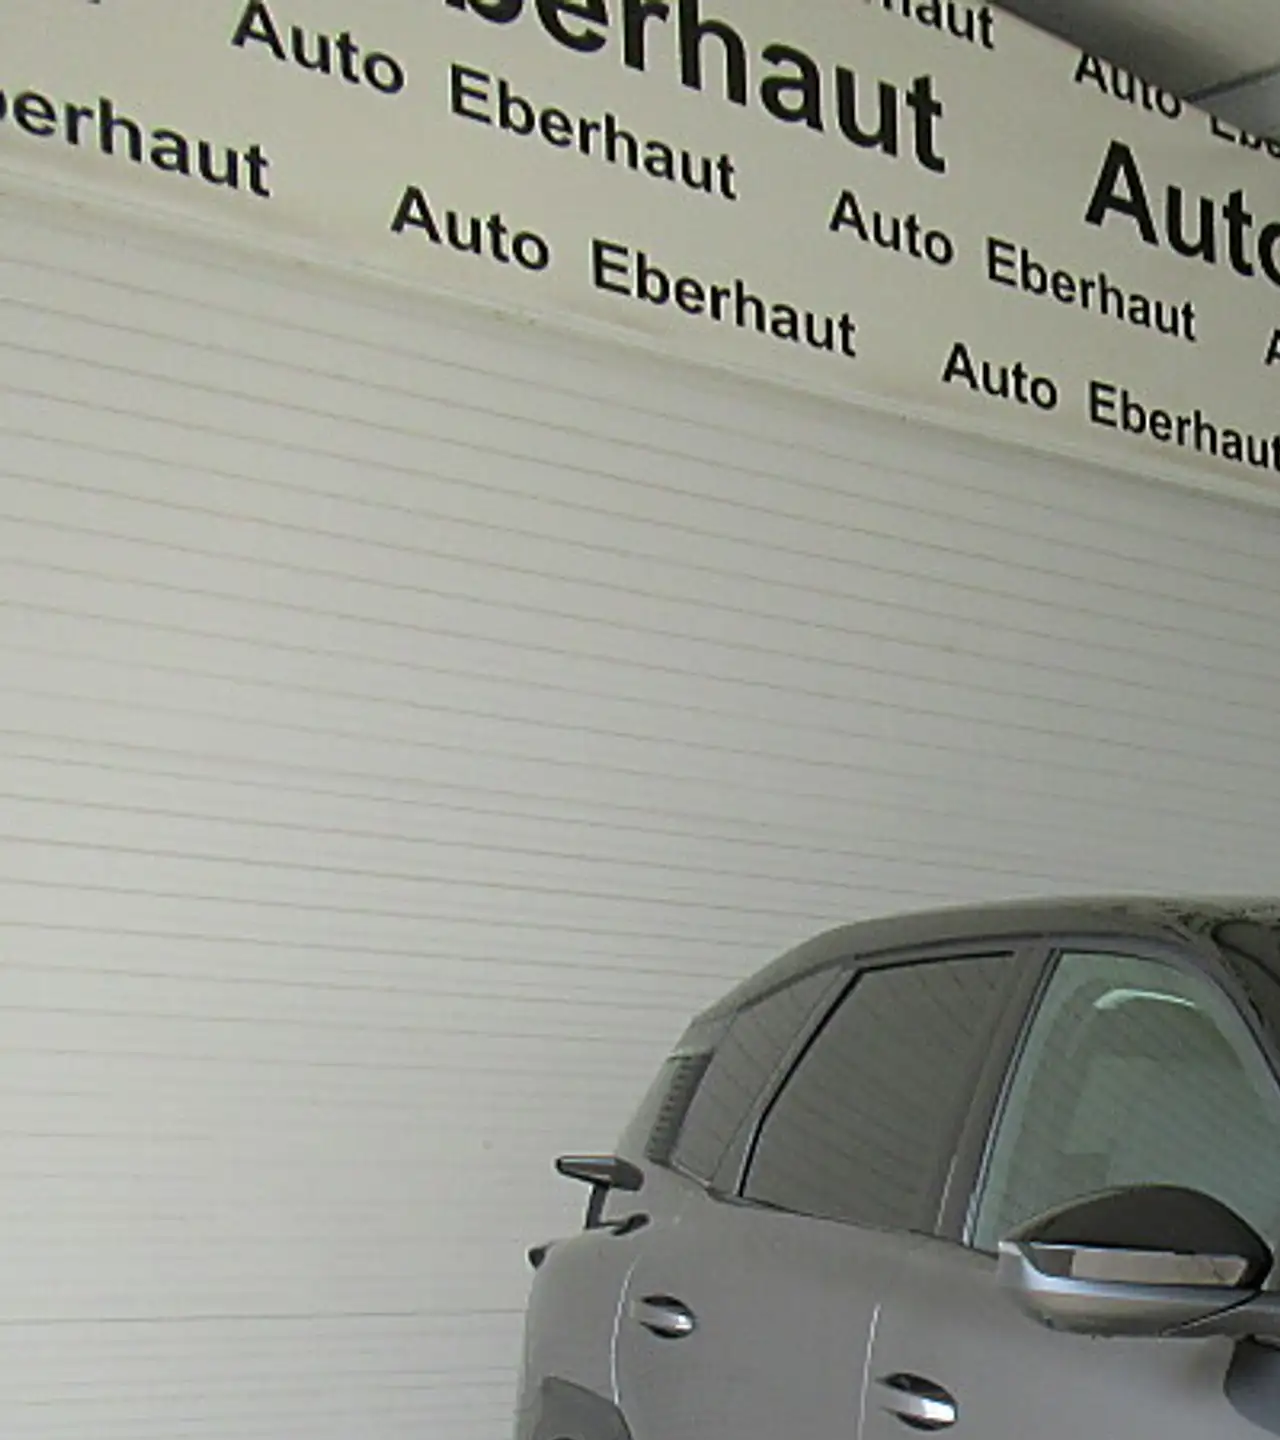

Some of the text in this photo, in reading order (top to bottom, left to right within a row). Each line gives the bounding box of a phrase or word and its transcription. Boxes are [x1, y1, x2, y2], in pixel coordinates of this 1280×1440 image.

[0, 89, 271, 198] erhaut
[231, 0, 737, 201] Auto Eberhaut
[444, 0, 946, 174] erhaut
[390, 184, 857, 359] Auto Eberhaut
[828, 189, 1197, 343] Auto Eberhaut
[941, 341, 1058, 411] Auto
